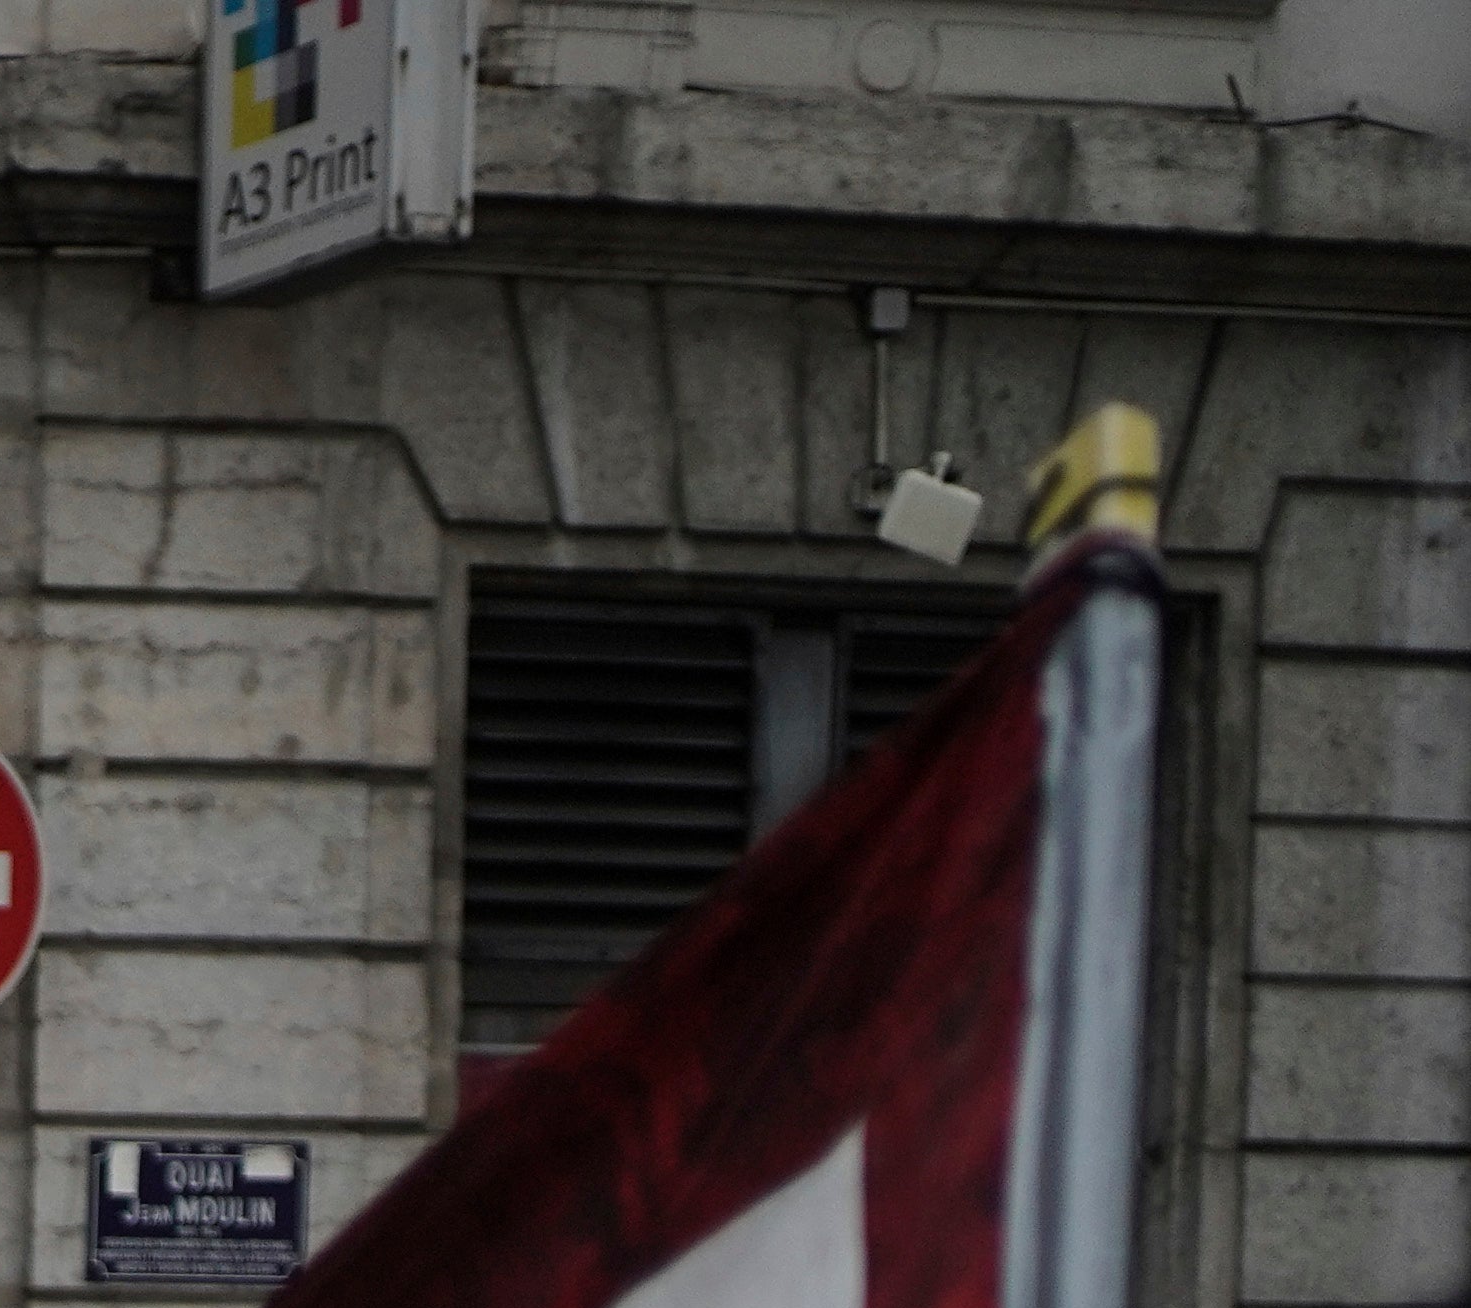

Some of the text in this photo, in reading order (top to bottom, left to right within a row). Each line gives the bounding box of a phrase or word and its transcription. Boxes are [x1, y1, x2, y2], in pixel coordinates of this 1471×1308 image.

[218, 161, 271, 235] A3
[284, 126, 379, 213] Print
[166, 1160, 235, 1193] QUAI
[175, 1195, 277, 1228] MOULIN
